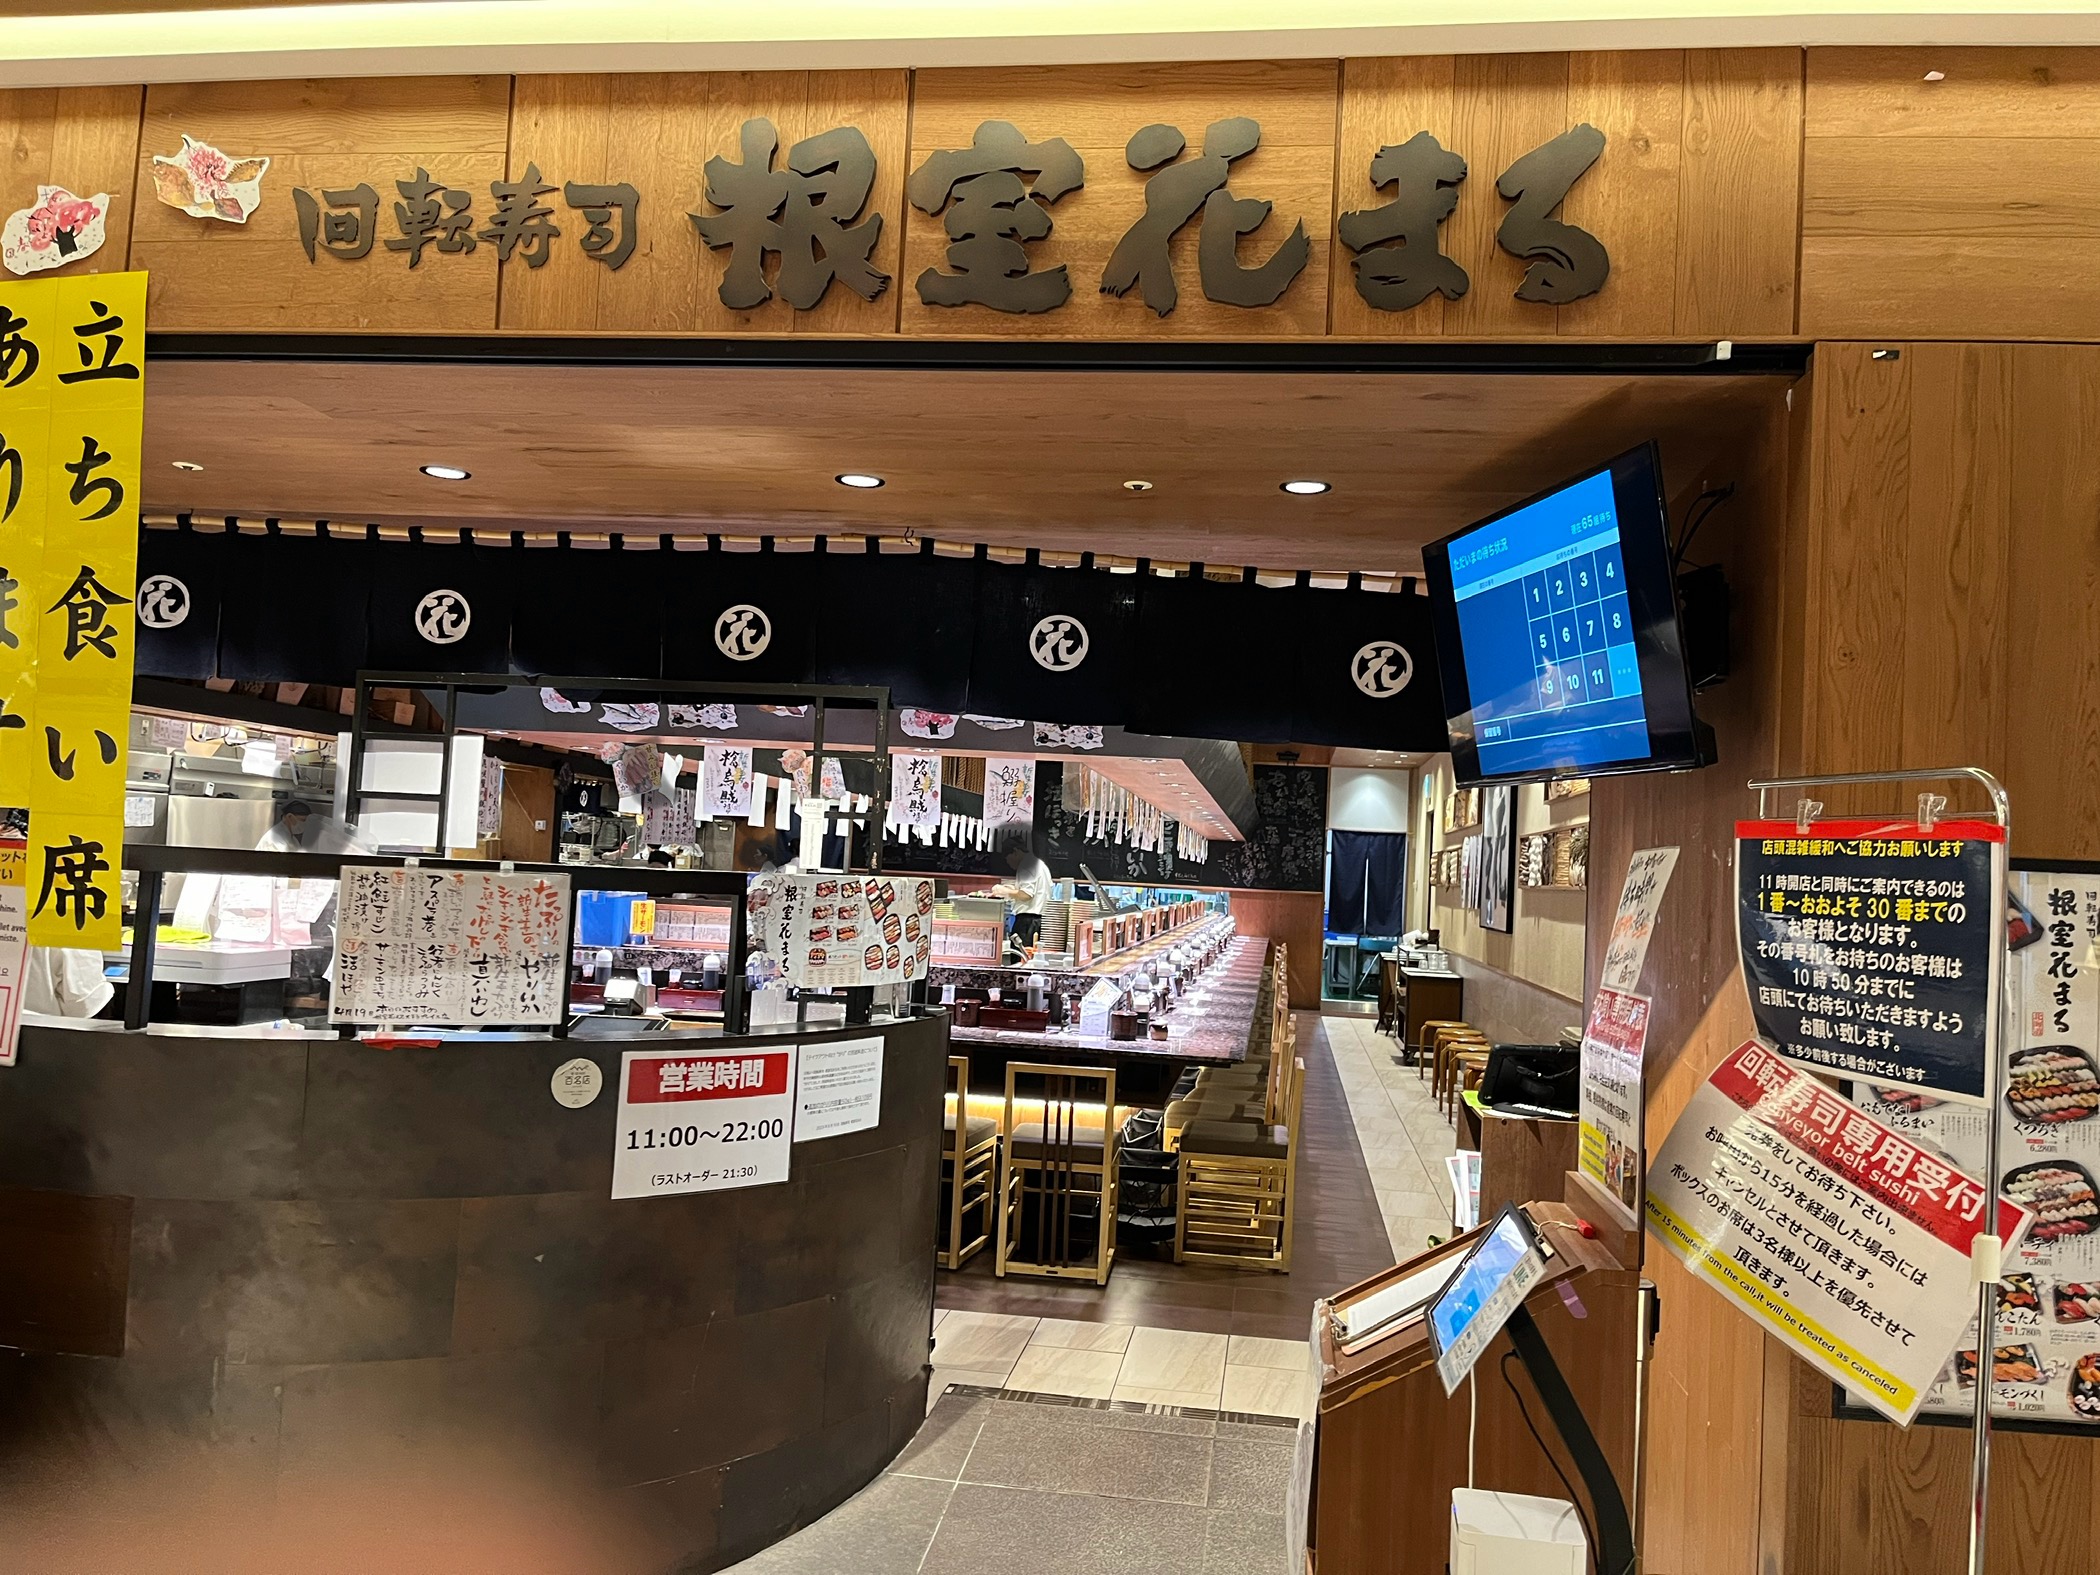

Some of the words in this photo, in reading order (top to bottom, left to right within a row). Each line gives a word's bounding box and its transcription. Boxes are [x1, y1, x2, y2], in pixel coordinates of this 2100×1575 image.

[292, 161, 641, 271] 回転寿司
[686, 116, 1611, 318] 根室花まる
[1453, 538, 1508, 571] ただいまの待ち状況
[1533, 588, 1540, 603] 1
[1555, 580, 1564, 596] 2
[1579, 571, 1588, 587] 3
[1605, 562, 1615, 578] 4
[31, 300, 141, 932] 立ち食い席
[1539, 634, 1547, 648] 5
[1562, 627, 1570, 642] 6
[1586, 620, 1594, 635] 7
[1612, 613, 1621, 629] 8
[1545, 680, 1553, 694] 9
[1567, 674, 1579, 690] 10
[1592, 668, 1604, 684] 11
[1762, 839, 1964, 858] 店頭混雑緩和へご協力お願いします
[779, 884, 798, 973] 根室花まる
[1788, 917, 1917, 948] お客様となります。
[1756, 940, 1963, 978] その番号札をお持ちのお客様は
[2047, 887, 2078, 1033] 根室花まる
[520, 957, 540, 1013] やりいか
[1759, 986, 1963, 1033] 店頭にてお待ちいただきますよう
[1800, 1016, 1901, 1052] お願い致します。
[659, 1058, 764, 1094] 営業時間
[1732, 1047, 1988, 1224] 回転寿司専用受付
[1831, 1141, 1869, 1174] belt
[1868, 1168, 1921, 1207] sushi
[1714, 1166, 1876, 1290] キャンセルとさせて頂きます。
[1669, 1163, 1917, 1347] ボックスのお席は3名様以上を優先させて
[1732, 1244, 1791, 1298] 頂きます。
[1661, 1215, 1672, 1227] 15
[1723, 1264, 1739, 1284] the
[1765, 1299, 1784, 1317] will
[1783, 1311, 1798, 1326] be
[1797, 1322, 1836, 1353] treated
[1835, 1350, 1850, 1363] as
[1850, 1360, 1899, 1396] canceled
[1993, 1388, 2044, 1401] ーモンづくし
